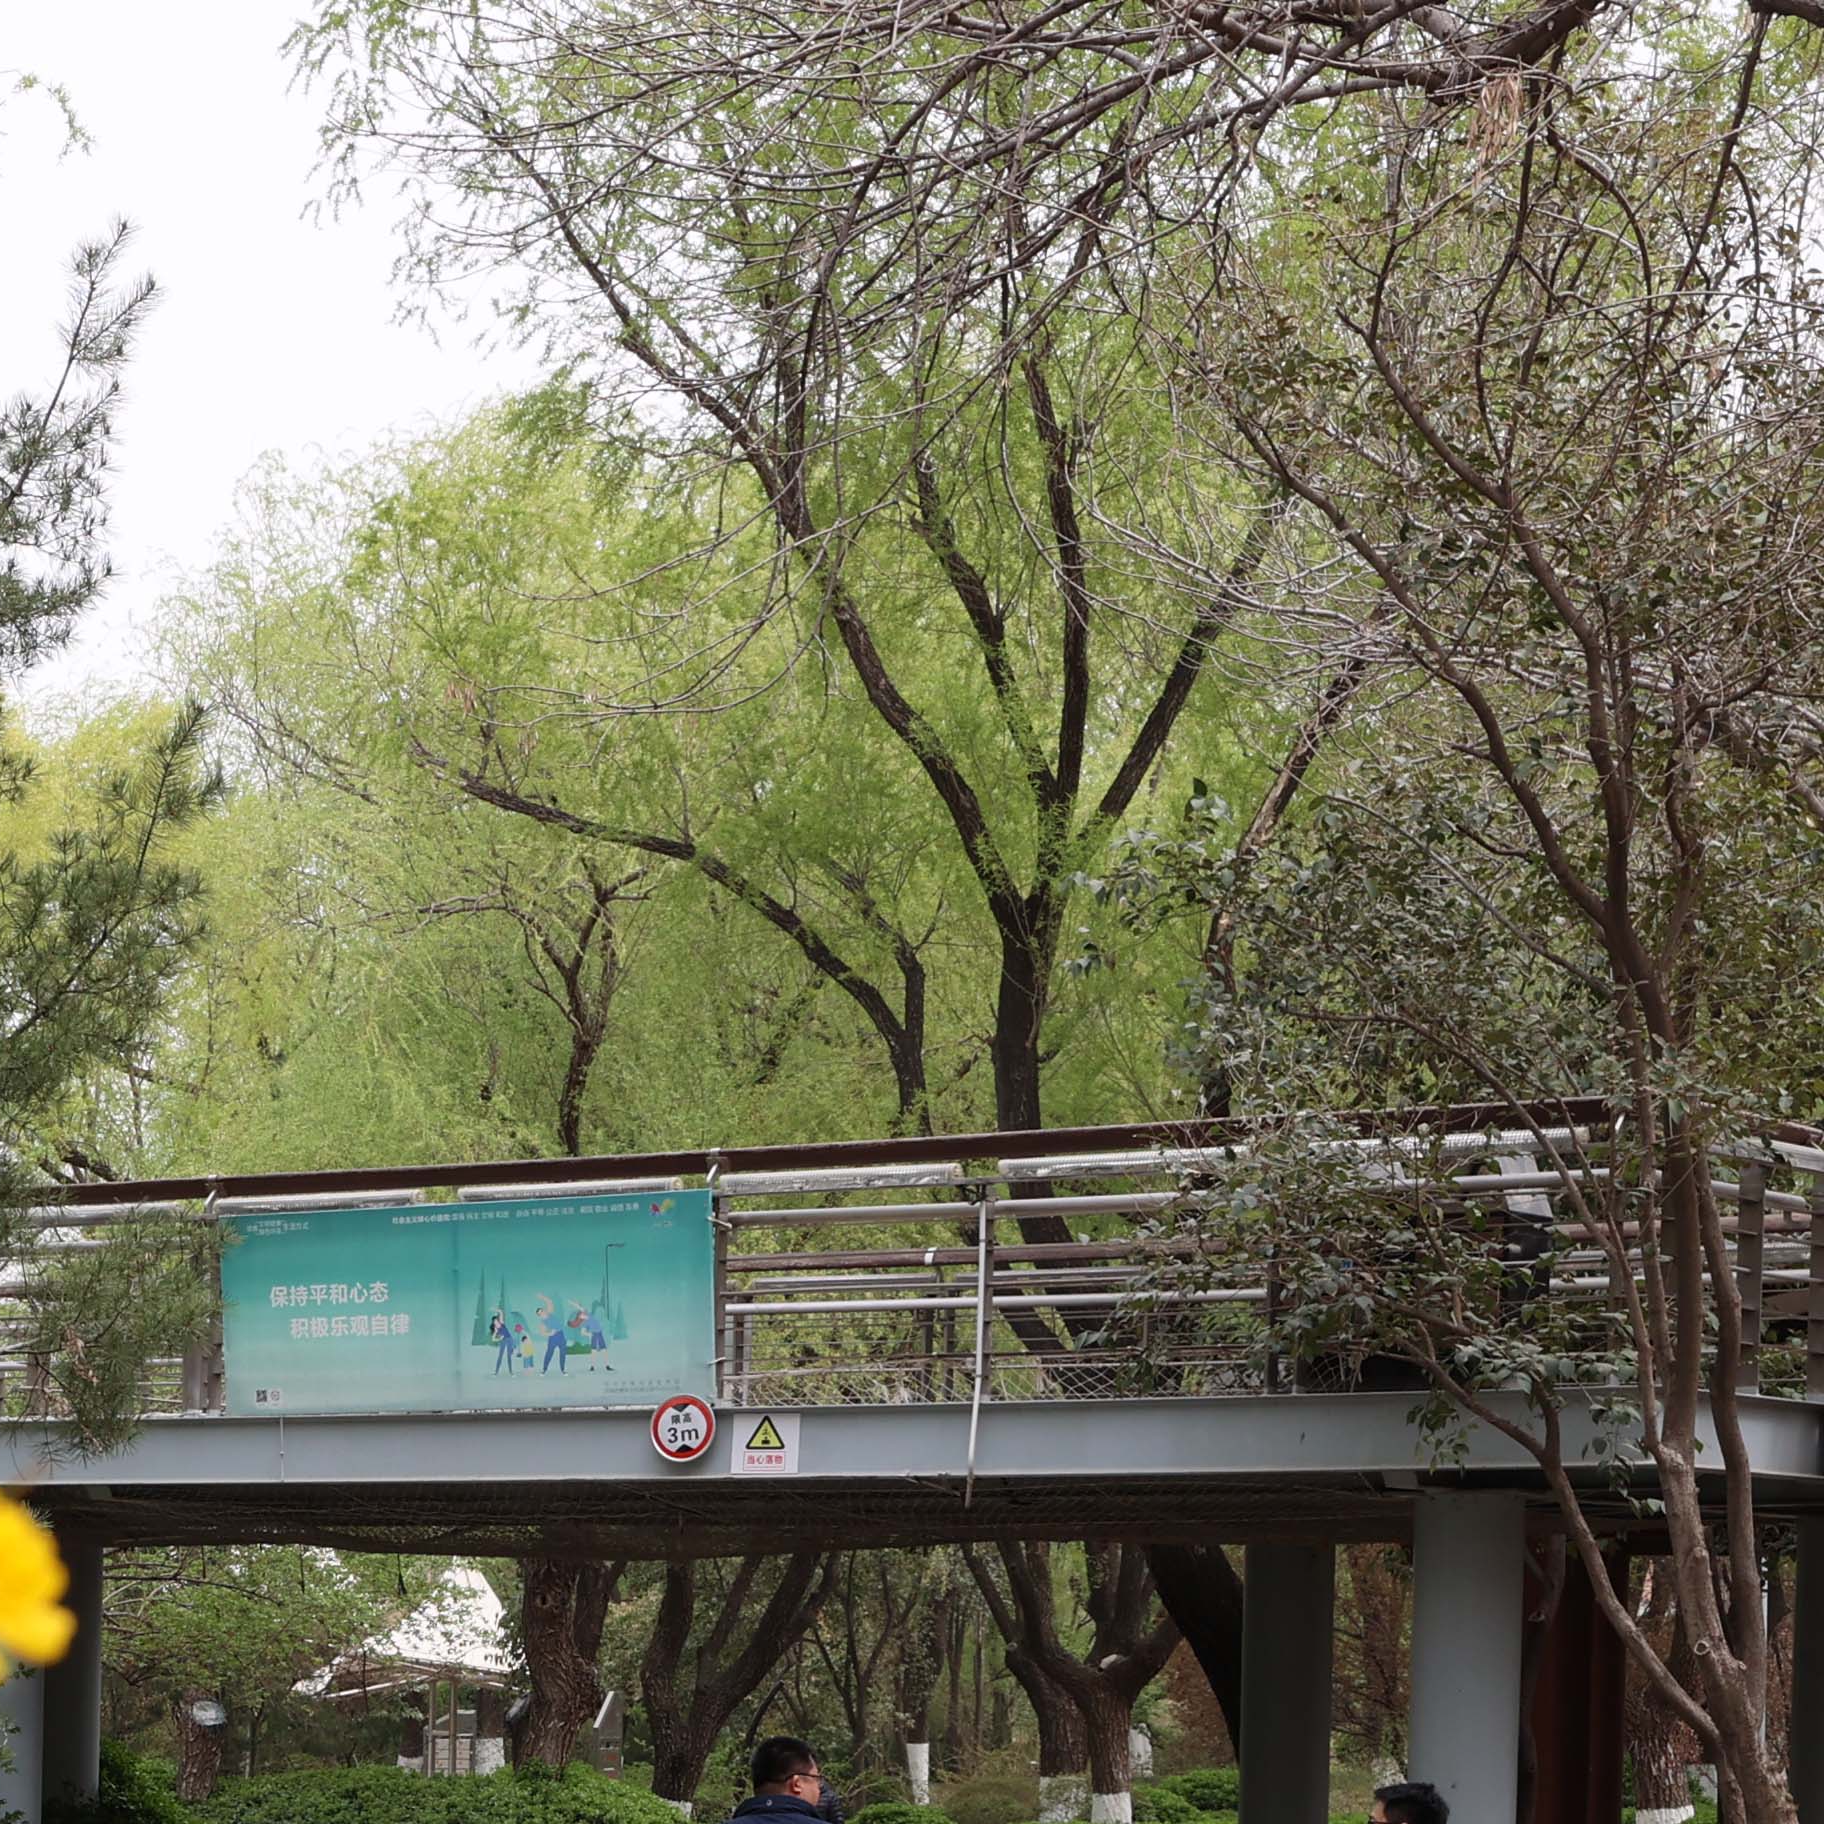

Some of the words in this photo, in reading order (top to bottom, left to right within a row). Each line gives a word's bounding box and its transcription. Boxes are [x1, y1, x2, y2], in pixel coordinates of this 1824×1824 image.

[270, 1281, 388, 1307] 保持平和心态
[290, 1314, 409, 1339] 积极乐观自律
[671, 1414, 692, 1424] 限高
[667, 1428, 699, 1443] 3m
